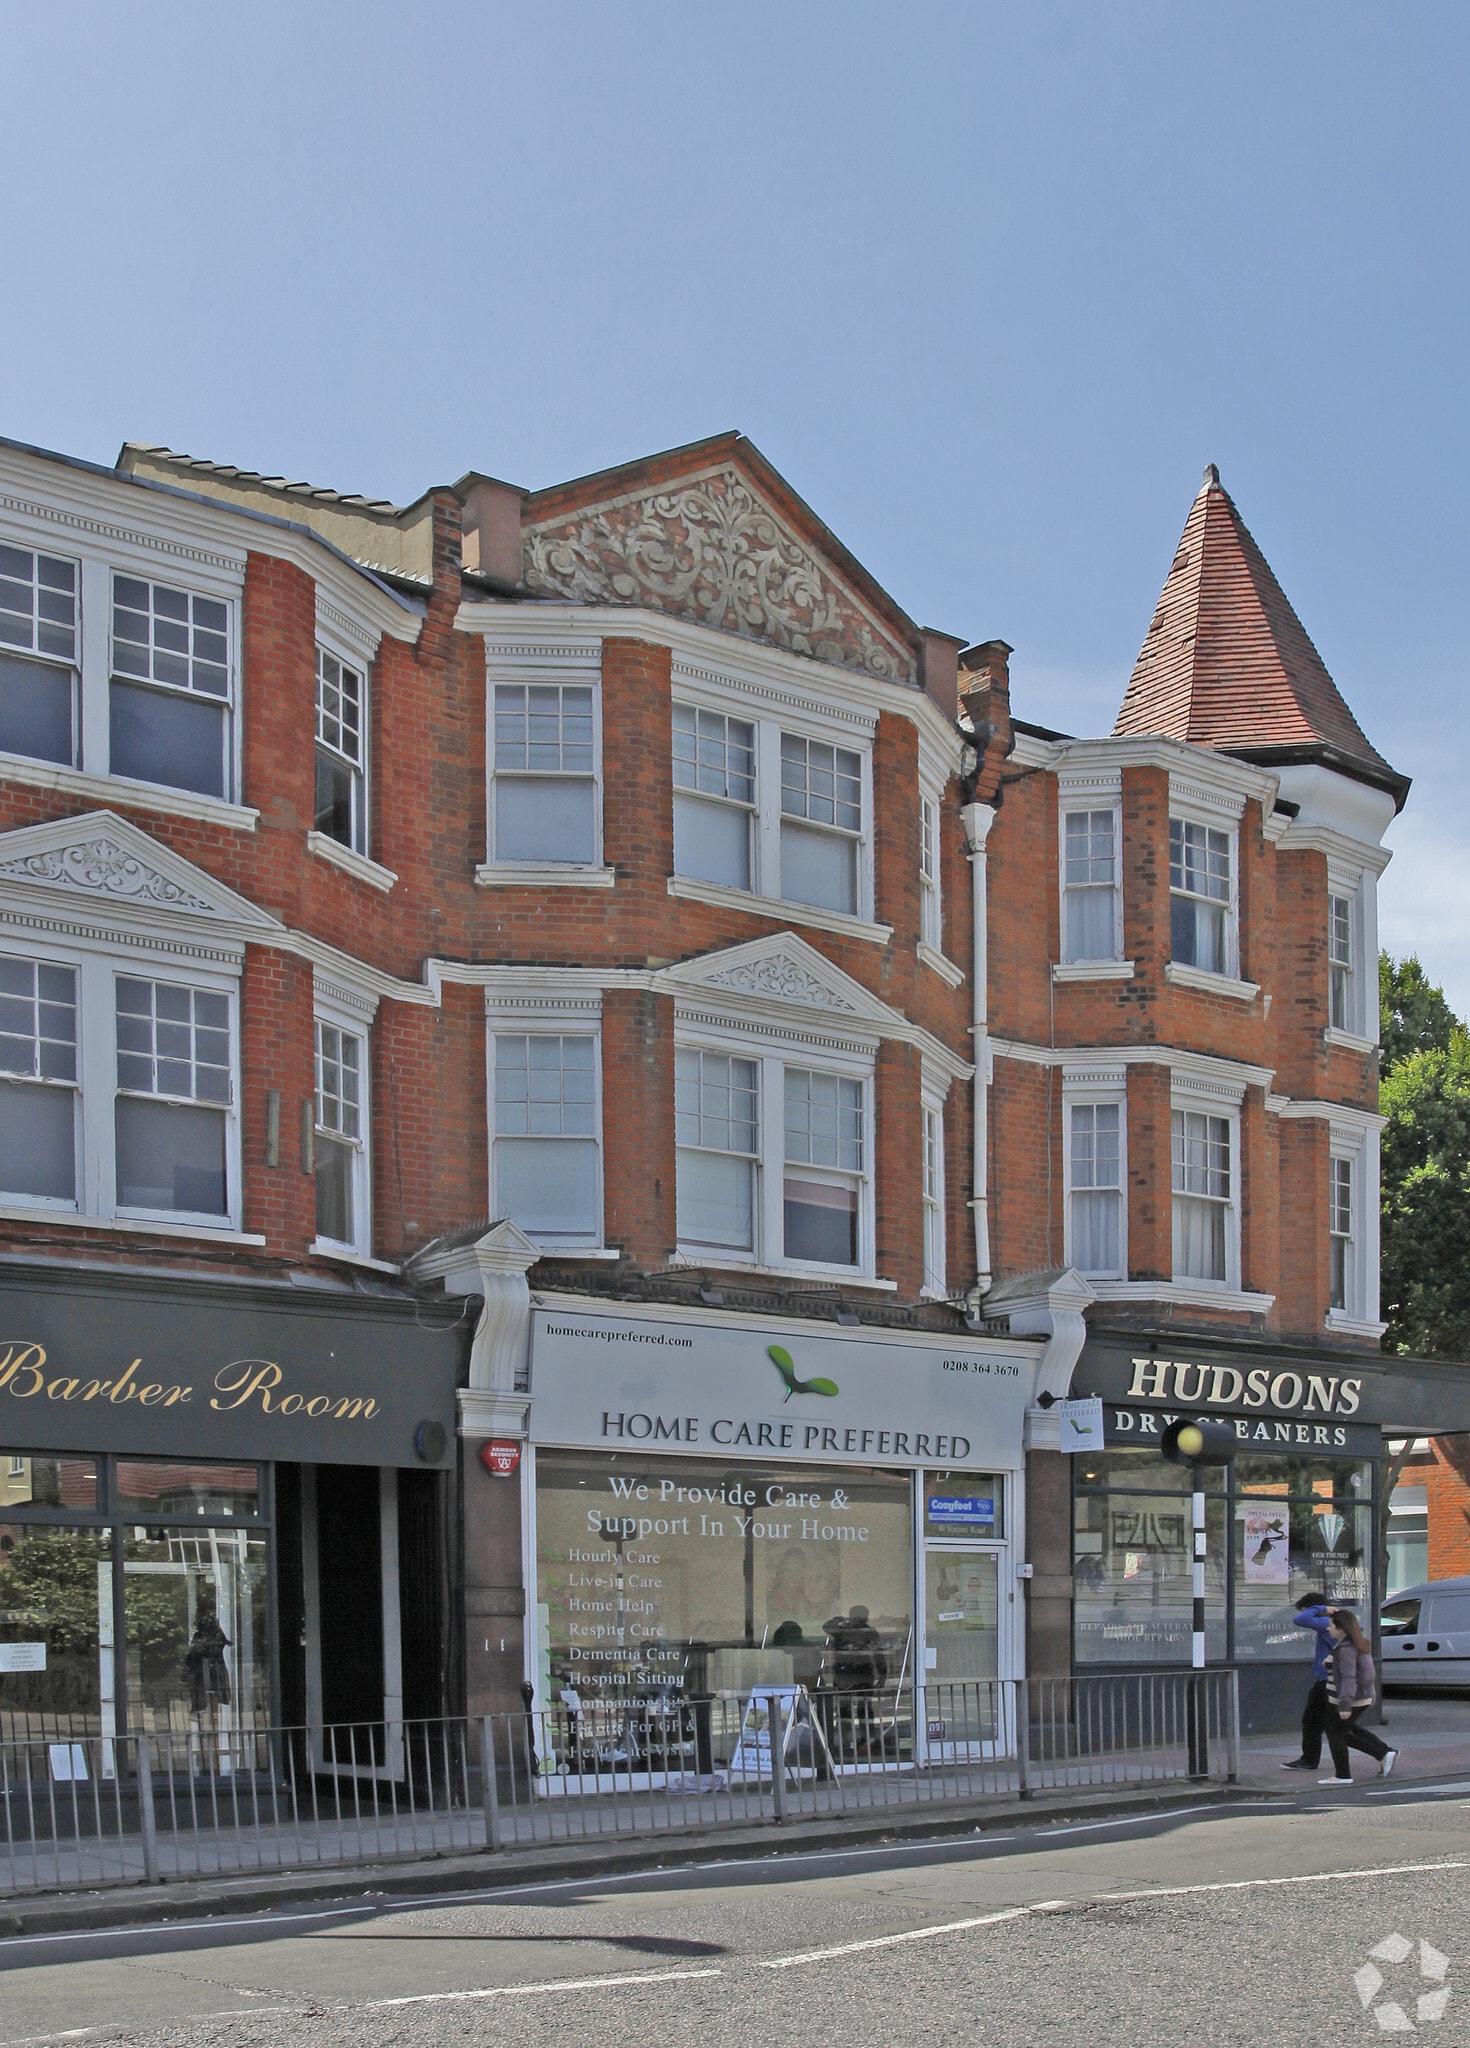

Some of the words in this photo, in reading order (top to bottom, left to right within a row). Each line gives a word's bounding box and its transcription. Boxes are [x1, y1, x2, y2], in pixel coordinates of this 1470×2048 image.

[546, 1323, 694, 1348] homecarepreferred.com
[943, 1360, 969, 1372] 0208
[971, 1362, 991, 1374] 364
[994, 1364, 1019, 1376] 3670
[0, 1340, 193, 1407] Barber
[209, 1359, 381, 1419] Room
[1126, 1358, 1362, 1415] HUDSONS
[601, 1411, 699, 1442] HOME
[710, 1419, 794, 1448] CARE
[804, 1426, 972, 1459] PREFERRED
[1197, 1416, 1347, 1446] EANERS
[608, 1477, 649, 1500] We
[659, 1480, 757, 1506] Provide
[765, 1486, 821, 1509] Care
[830, 1489, 850, 1510] &
[587, 1510, 690, 1541] Support
[699, 1514, 724, 1537] In
[733, 1516, 792, 1539] Your
[801, 1519, 869, 1542] Home
[568, 1548, 620, 1566] Hourly
[626, 1550, 661, 1564] Care
[568, 1573, 624, 1587] Live-in
[628, 1575, 662, 1588] Care
[568, 1598, 613, 1612] Home
[619, 1599, 654, 1614] Help
[569, 1623, 624, 1638] Respite
[630, 1623, 664, 1636] Care
[1151, 1622, 1217, 1632] ALTERATNS
[569, 1647, 641, 1660] Dementia
[646, 1648, 680, 1660] Care
[569, 1672, 632, 1687] Hospital
[637, 1672, 685, 1687] Sitting
[580, 1696, 685, 1710] ompanionship
